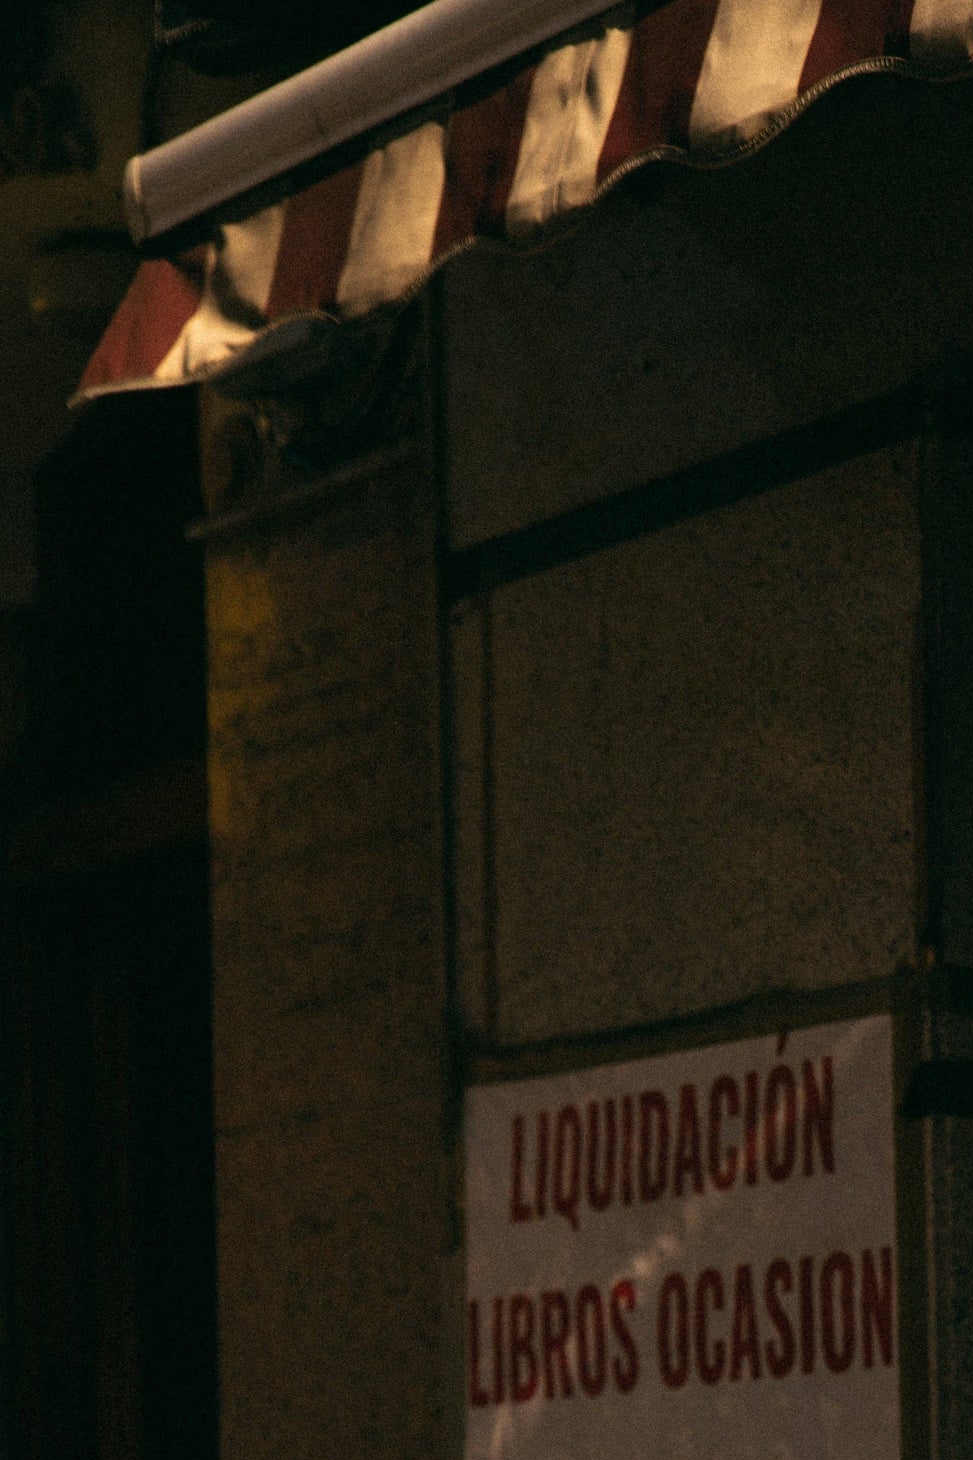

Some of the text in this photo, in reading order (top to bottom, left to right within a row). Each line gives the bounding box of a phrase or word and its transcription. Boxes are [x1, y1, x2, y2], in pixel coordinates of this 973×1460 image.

[510, 1027, 834, 1230] LIQUIDACIÓN
[468, 1246, 894, 1406] LIBROS OCASION
